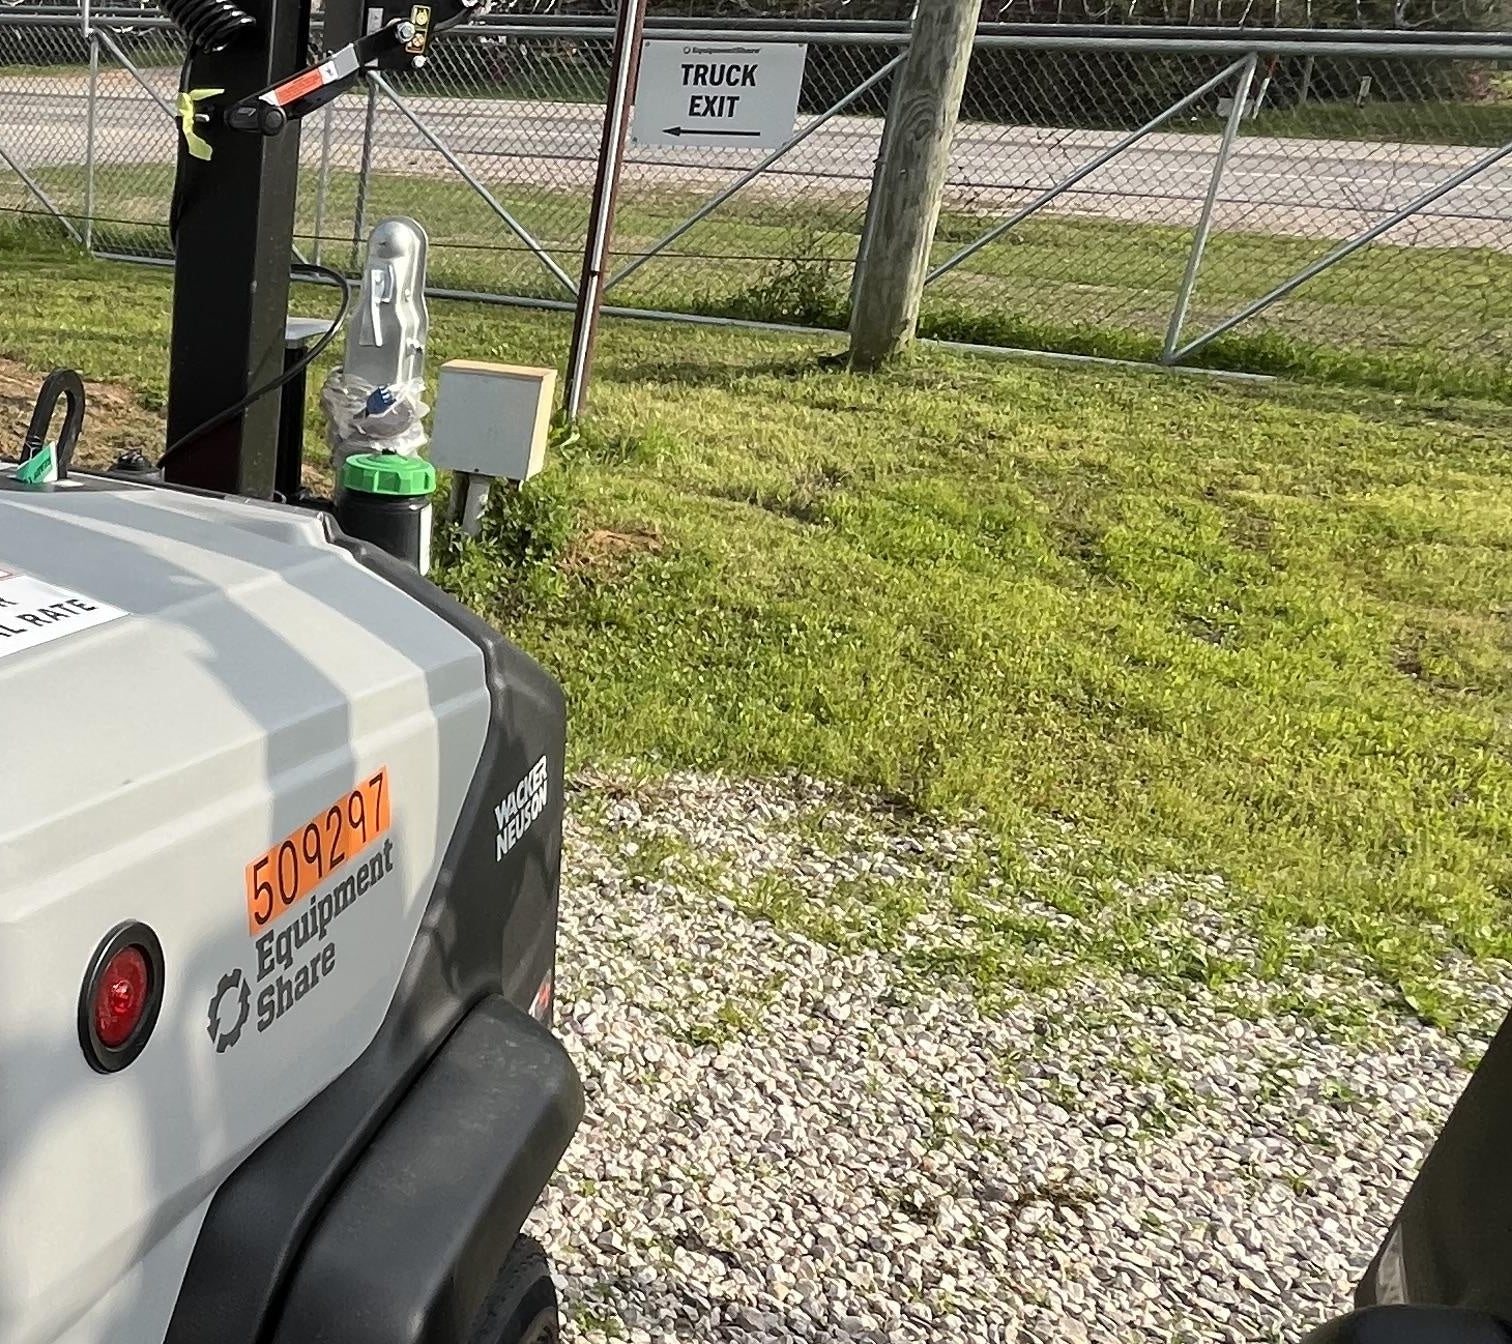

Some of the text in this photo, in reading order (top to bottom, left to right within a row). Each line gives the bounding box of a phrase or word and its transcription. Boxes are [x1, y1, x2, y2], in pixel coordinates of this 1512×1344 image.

[681, 64, 759, 87] TRUCK
[688, 95, 740, 117] EXIT
[15, 598, 99, 627] RATE
[494, 755, 548, 831] WACKER
[496, 779, 548, 862] NEUSON
[252, 771, 384, 926] 509297
[255, 838, 393, 983] Equipment
[256, 942, 336, 1033] Share
